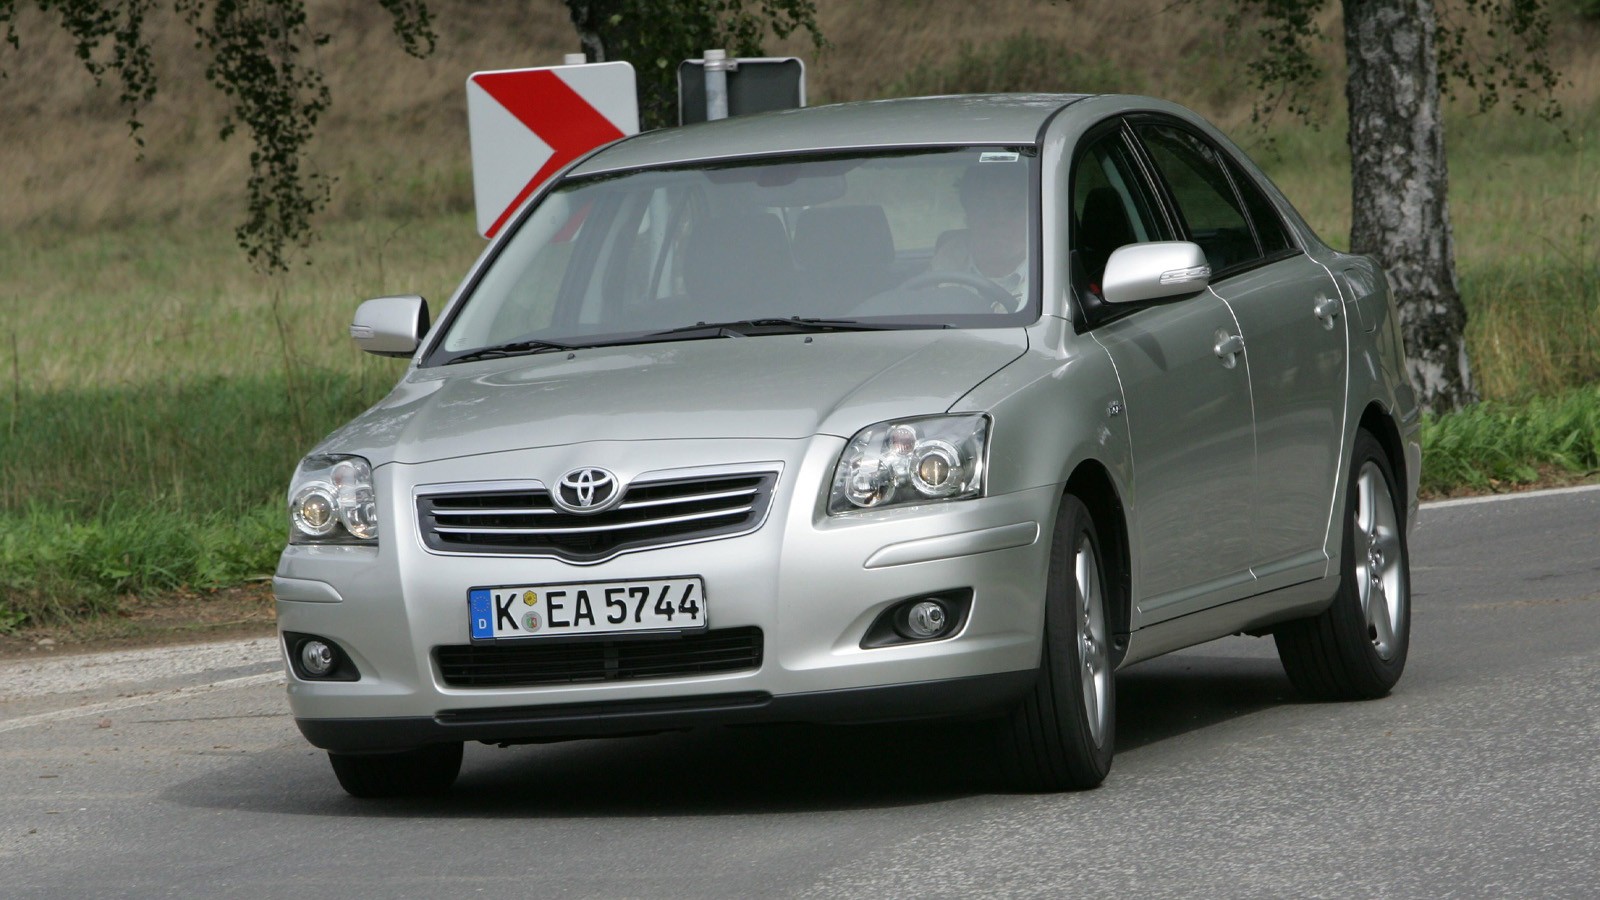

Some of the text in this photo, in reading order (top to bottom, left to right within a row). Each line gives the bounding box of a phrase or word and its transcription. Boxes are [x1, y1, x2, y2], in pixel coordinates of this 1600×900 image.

[495, 584, 699, 631] K EA 5744
[478, 618, 487, 630] D
